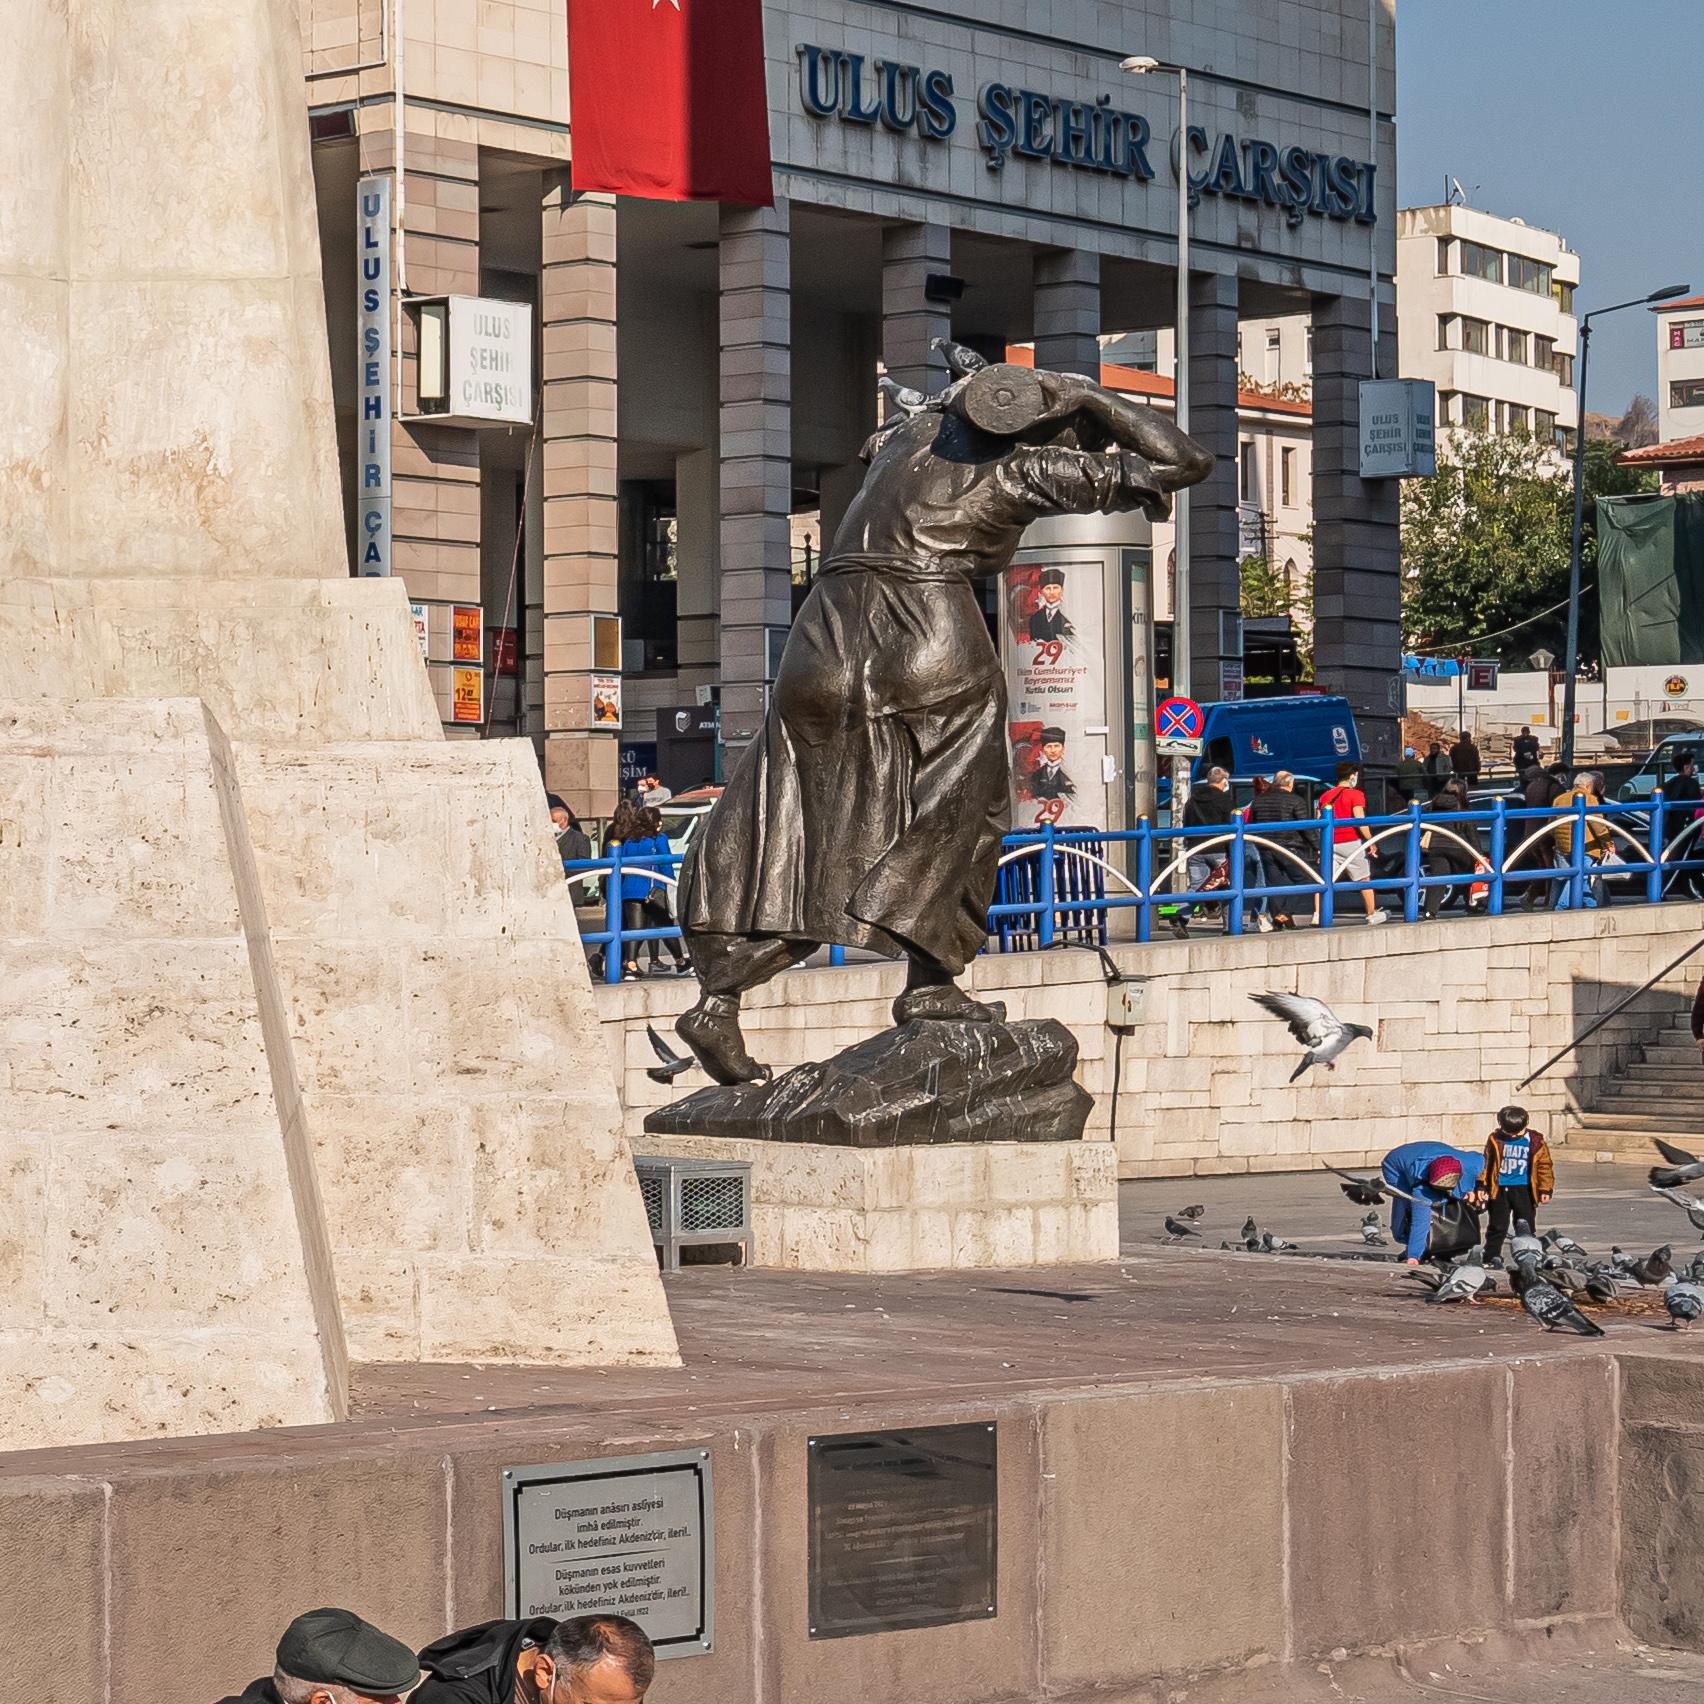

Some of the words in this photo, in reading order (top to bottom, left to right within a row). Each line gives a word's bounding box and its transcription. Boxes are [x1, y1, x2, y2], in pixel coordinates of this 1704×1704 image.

[795, 42, 957, 140] ULUS
[976, 80, 1156, 181] ŞEHİR
[1170, 124, 1378, 226] ÇARŞISI
[363, 194, 380, 312] ULUS
[473, 313, 511, 339] ULUS
[363, 327, 381, 488] ŞEHİR
[1372, 413, 1399, 425] ULUS
[1369, 426, 1402, 443] ŞEHİR
[1364, 442, 1407, 459] ÇARŞISI
[364, 510, 382, 577] ÇA
[1032, 640, 1063, 665] 29
[1047, 685, 1074, 694] Olsun
[1034, 799, 1065, 824] 29
[1499, 1159, 1527, 1175] UP?
[555, 1506, 598, 1521] Düşmanın
[578, 1533, 616, 1549] hedefiniz
[556, 1567, 599, 1582] Düşmanın
[601, 1564, 621, 1576] esas
[623, 1557, 665, 1573] kuvvetleri
[559, 1581, 601, 1596] kökünden
[603, 1579, 618, 1593] yok
[577, 1595, 615, 1609] hedefiniz
